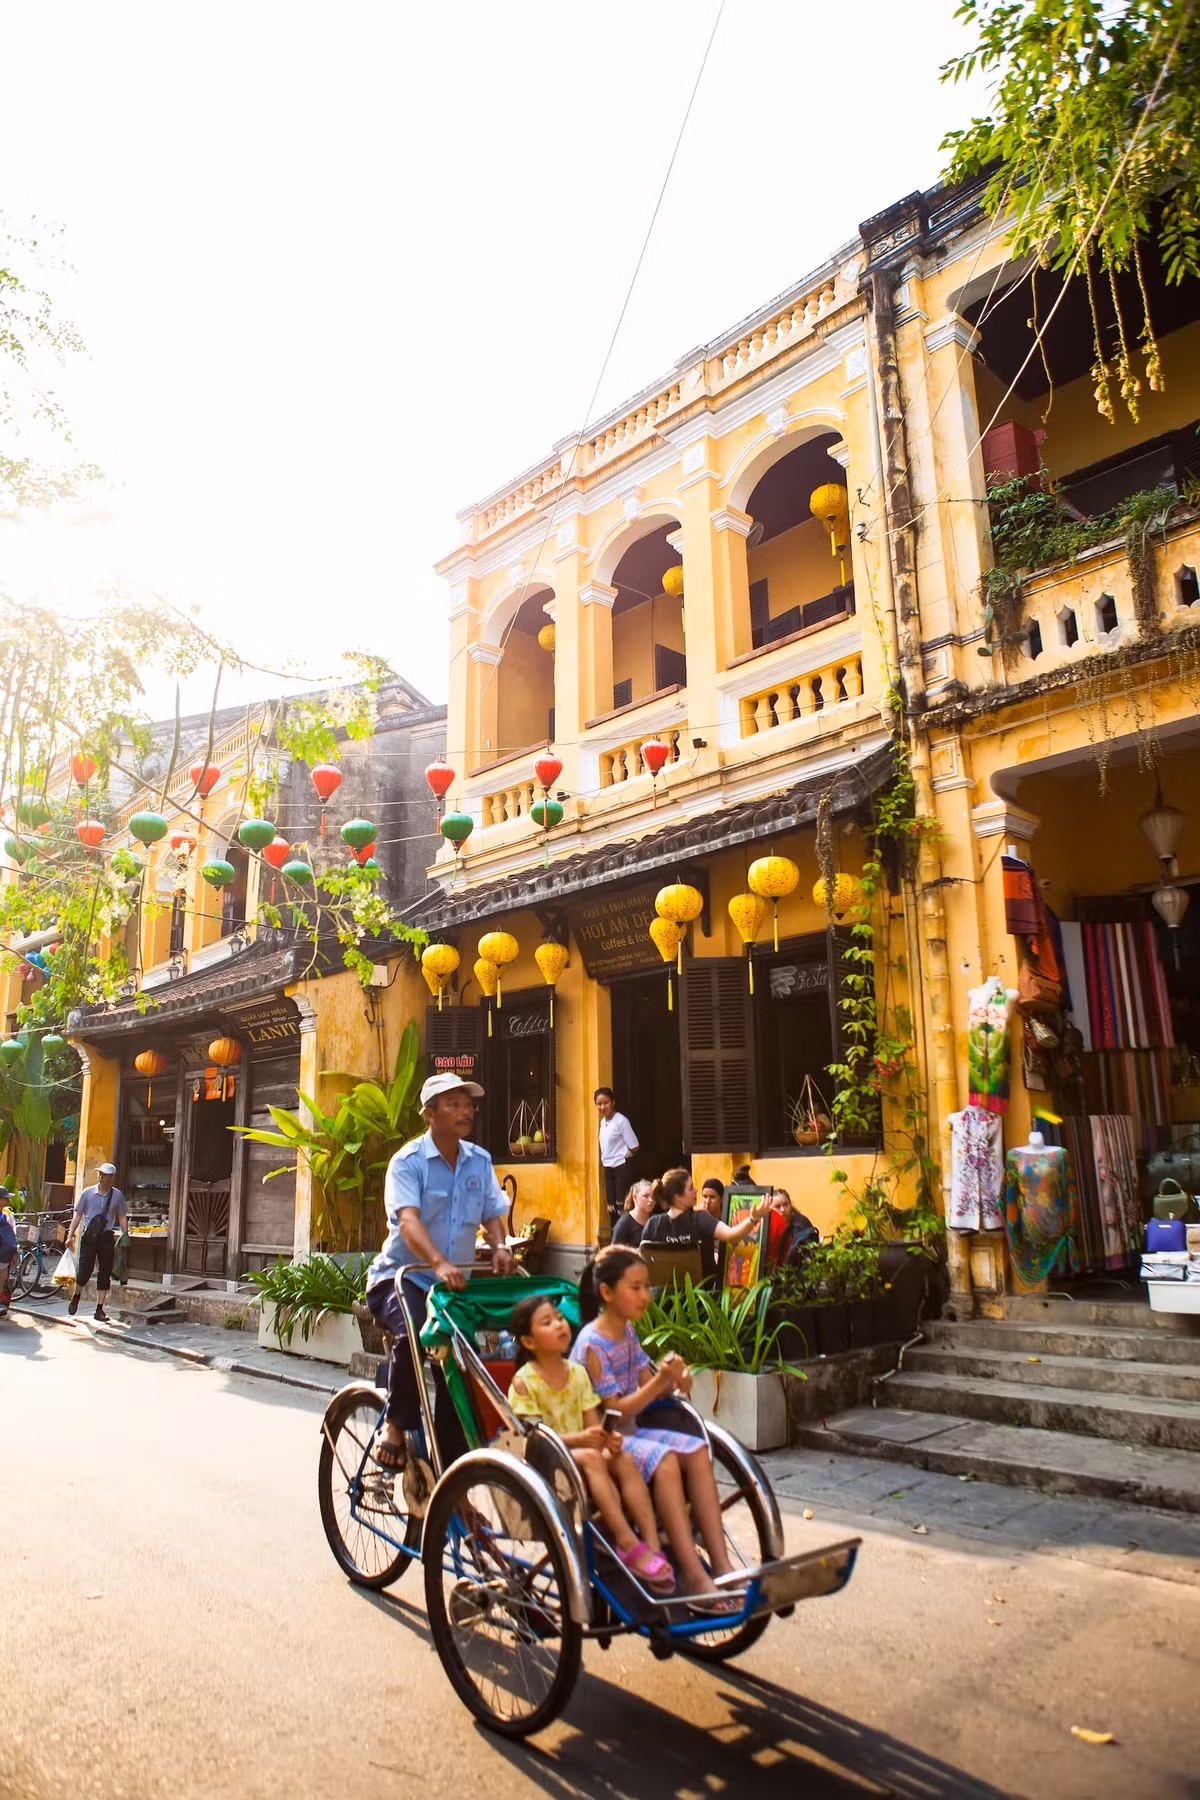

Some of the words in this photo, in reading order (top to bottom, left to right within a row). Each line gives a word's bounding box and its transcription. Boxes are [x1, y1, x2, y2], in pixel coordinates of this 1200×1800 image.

[610, 916, 630, 935] AN
[601, 937, 627, 951] Coffee
[628, 935, 635, 945] &
[636, 931, 651, 943] foo
[435, 1056, 455, 1068] CAO
